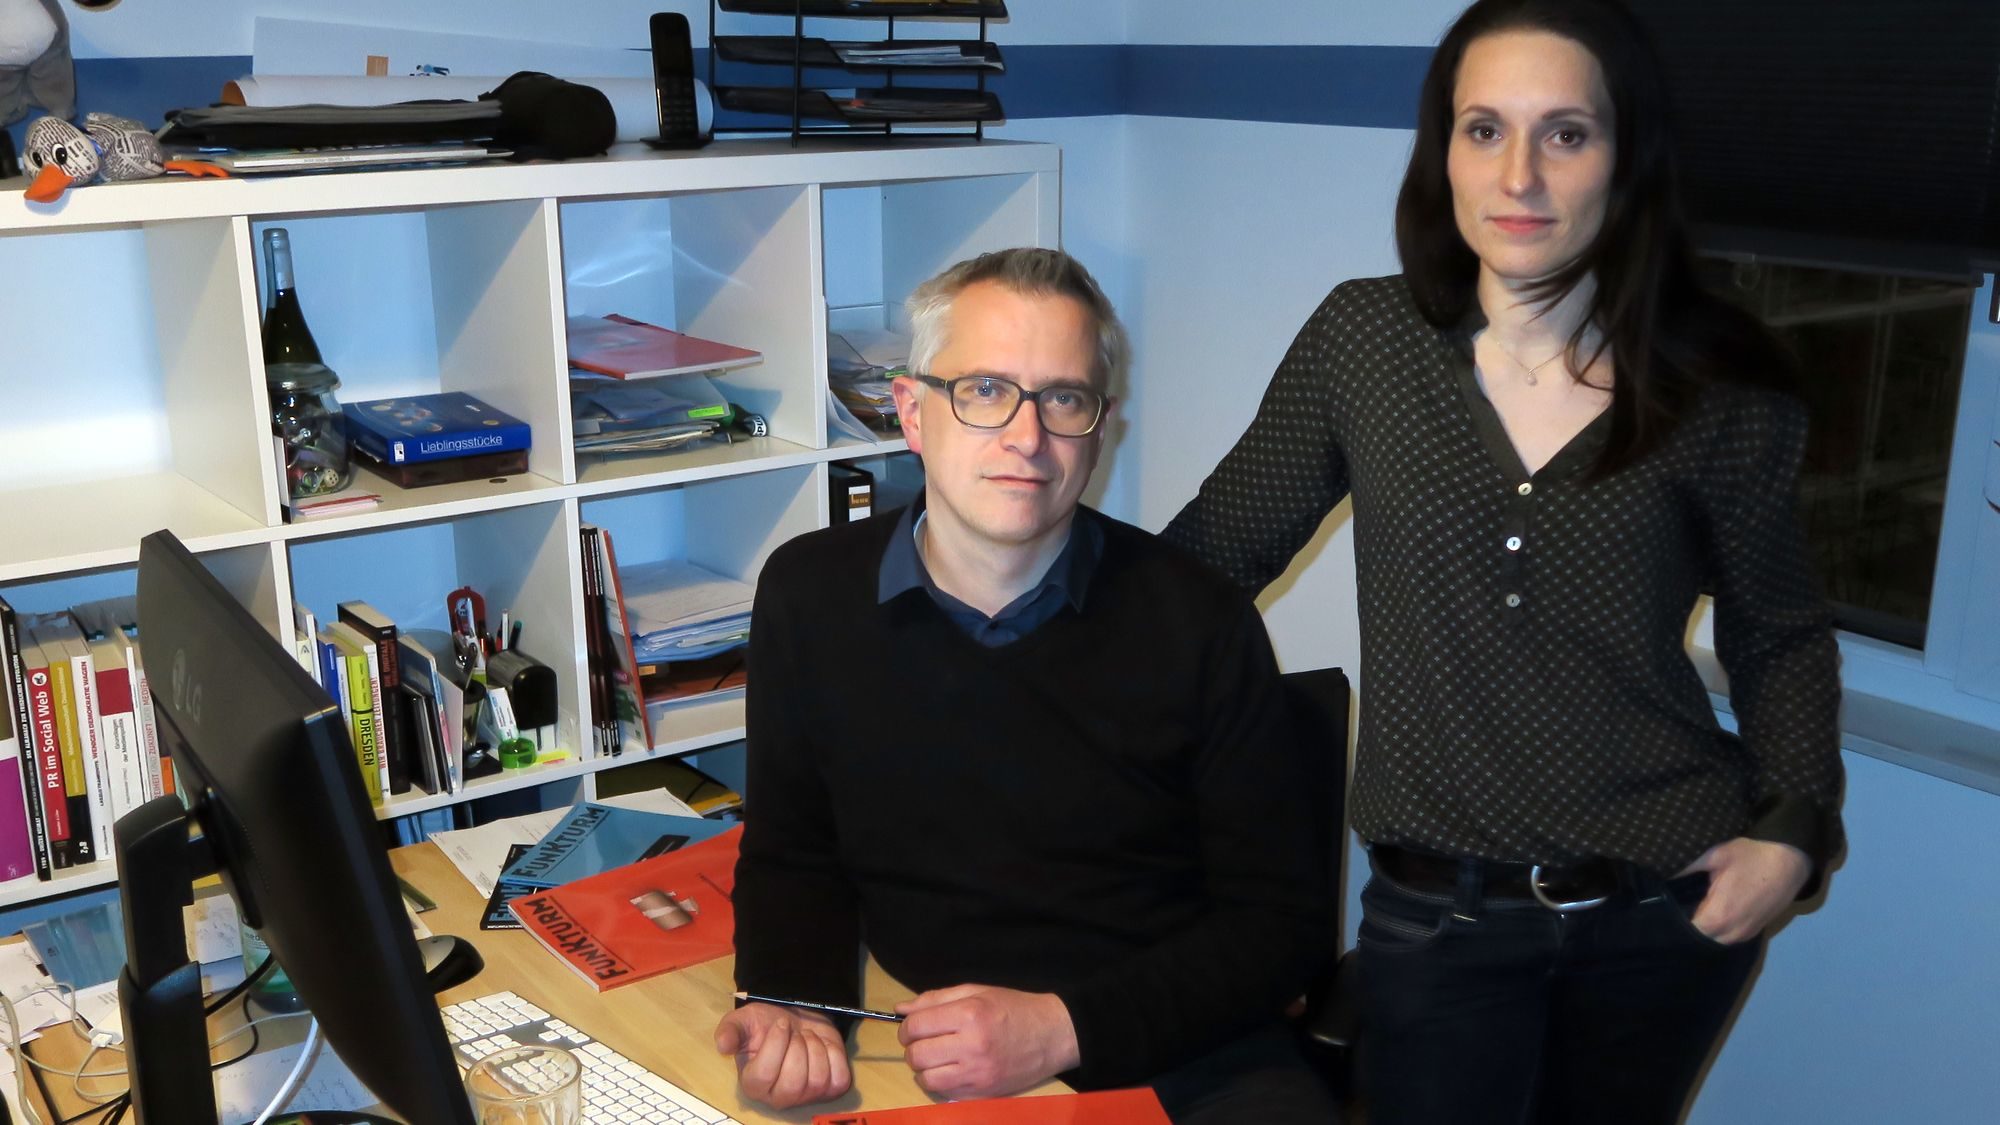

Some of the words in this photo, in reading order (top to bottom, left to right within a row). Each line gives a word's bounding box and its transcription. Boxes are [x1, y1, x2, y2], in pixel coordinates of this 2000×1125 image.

[420, 434, 503, 454] Lieblingsstücke
[81, 661, 89, 686] WAGEN
[36, 691, 50, 717] Web
[84, 686, 94, 728] DEMOKRATIE
[140, 678, 150, 706] MEDIEN
[39, 719, 55, 752] Social
[89, 729, 98, 759] WENIGER
[145, 723, 156, 755] ZUKUNFT
[360, 718, 374, 766] DRESDEN
[374, 719, 385, 755] BRAUCHEN
[45, 755, 57, 770] im
[47, 772, 59, 788] PR
[152, 774, 161, 799] REIHEIT
[511, 806, 605, 877] FUNKTURM
[524, 897, 629, 980] FUNKTURM
